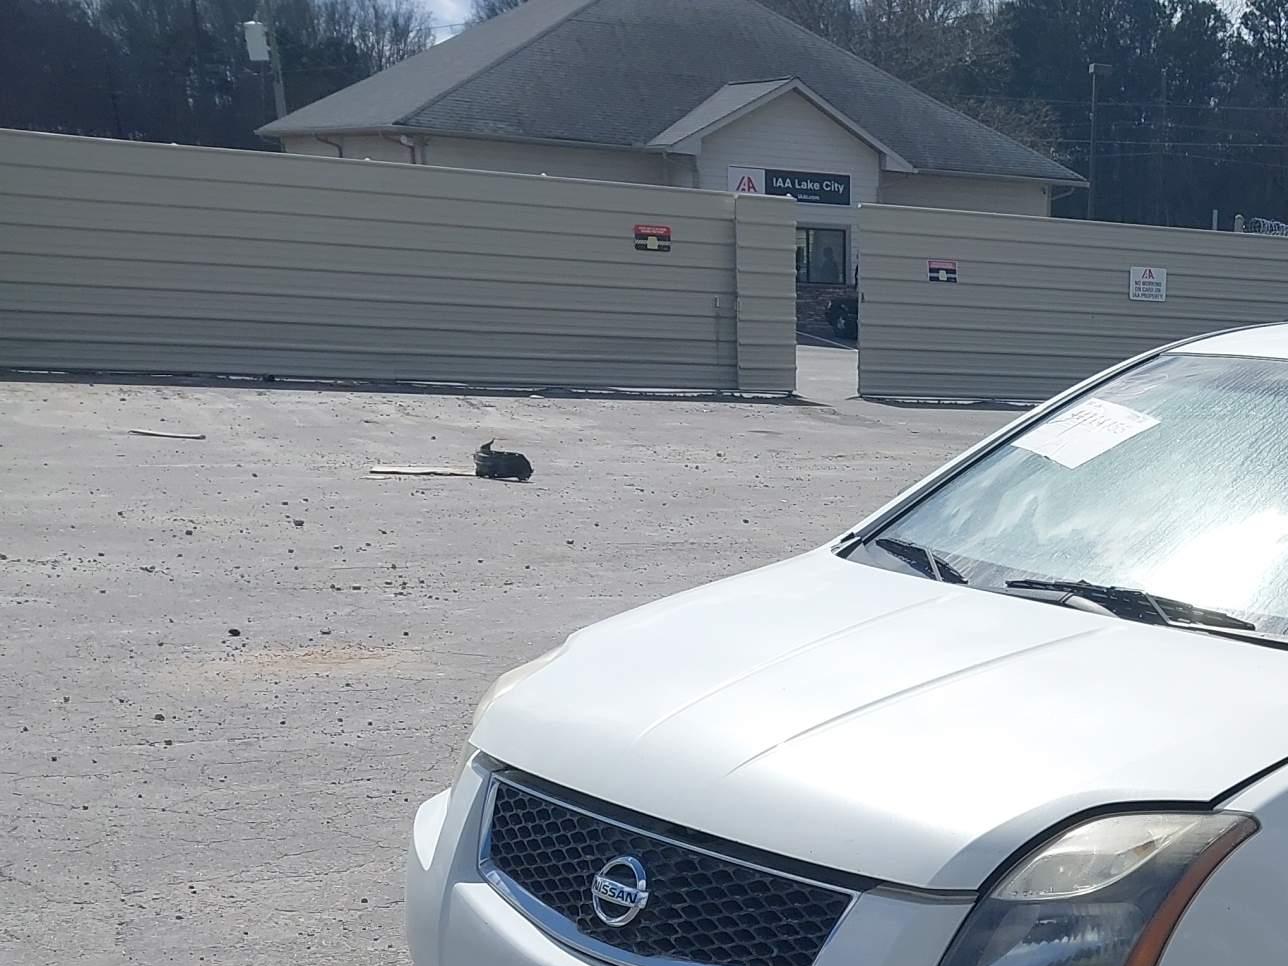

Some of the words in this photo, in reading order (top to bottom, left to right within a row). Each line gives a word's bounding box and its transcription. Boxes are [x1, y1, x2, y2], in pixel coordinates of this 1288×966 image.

[772, 177, 793, 189] IAA
[795, 178, 821, 191] Lake
[822, 181, 845, 194] City
[593, 880, 638, 904] NISSAN
